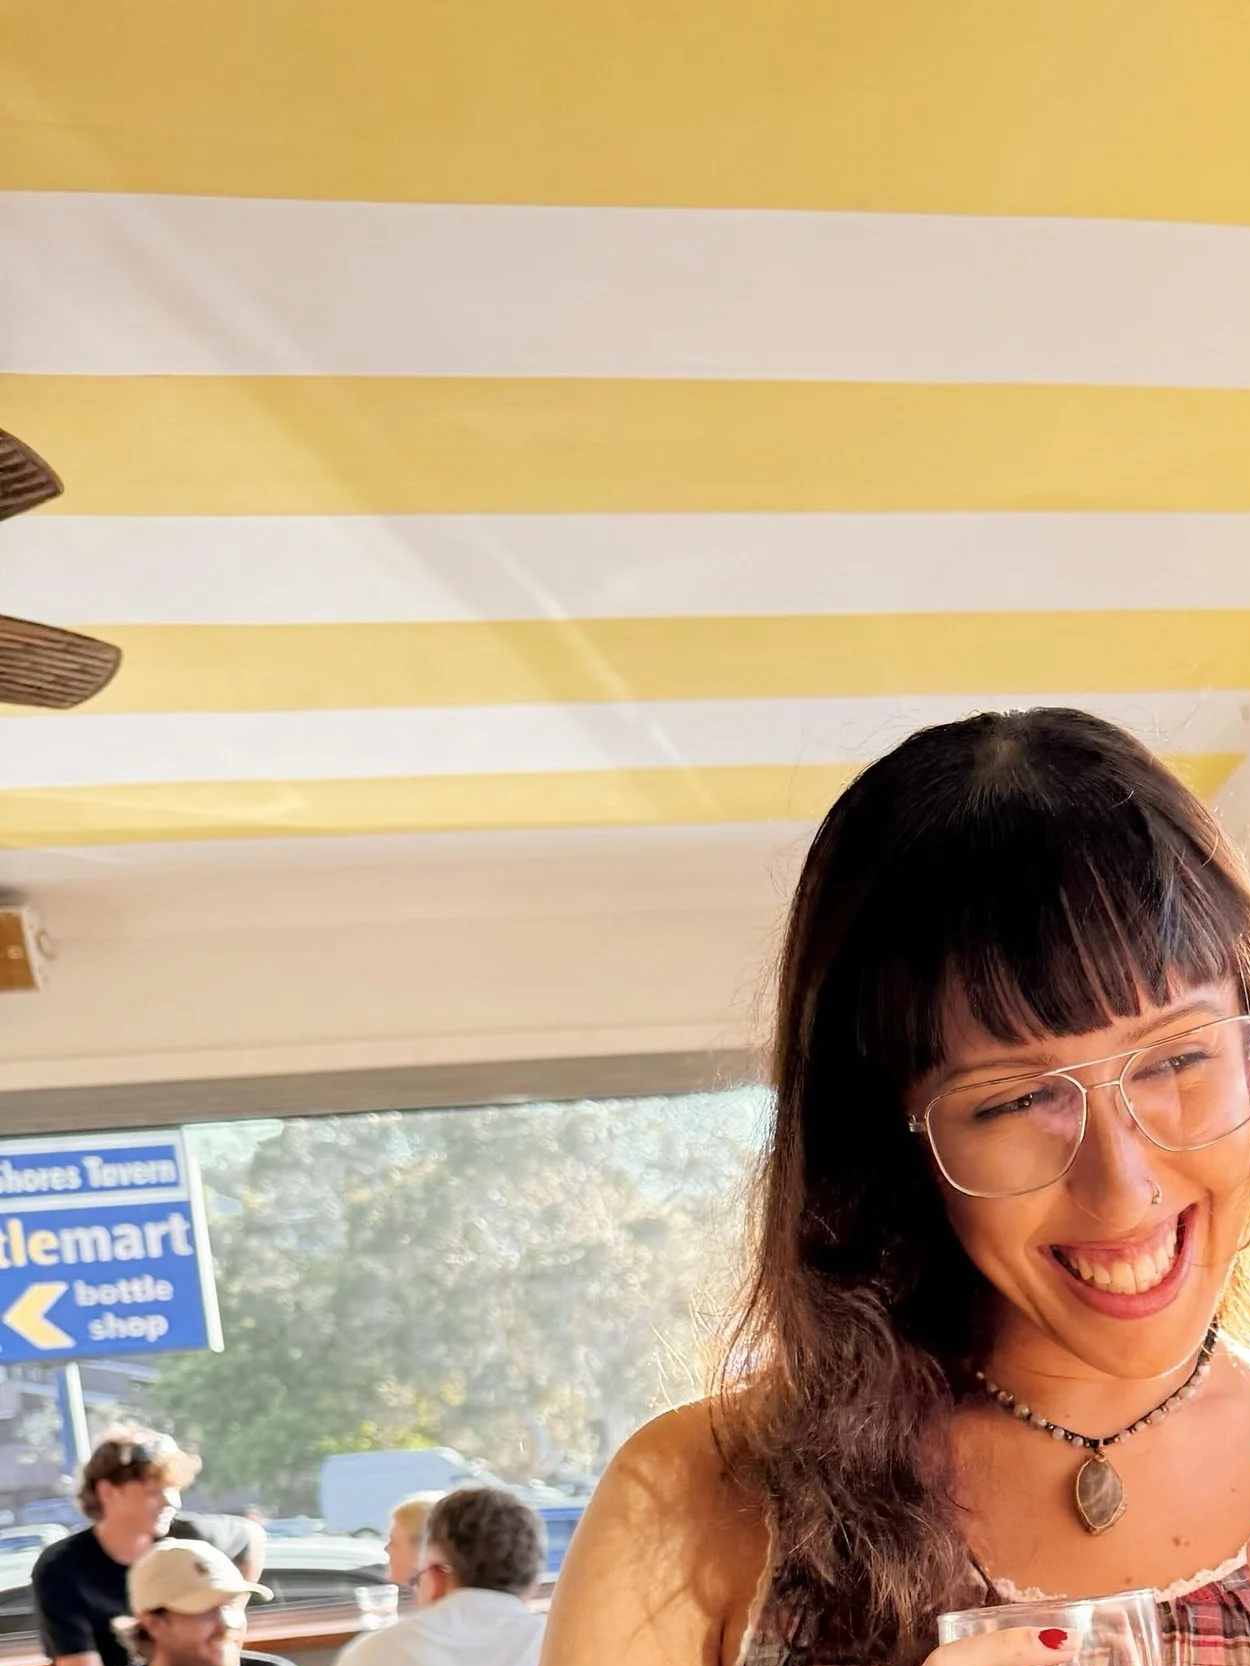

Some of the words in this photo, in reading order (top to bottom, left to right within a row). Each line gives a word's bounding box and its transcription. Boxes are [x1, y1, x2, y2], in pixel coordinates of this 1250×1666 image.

[0, 1160, 81, 1193] hores
[83, 1155, 176, 1187] Tavern
[74, 1274, 174, 1307] bottle
[88, 1311, 169, 1342] shop
